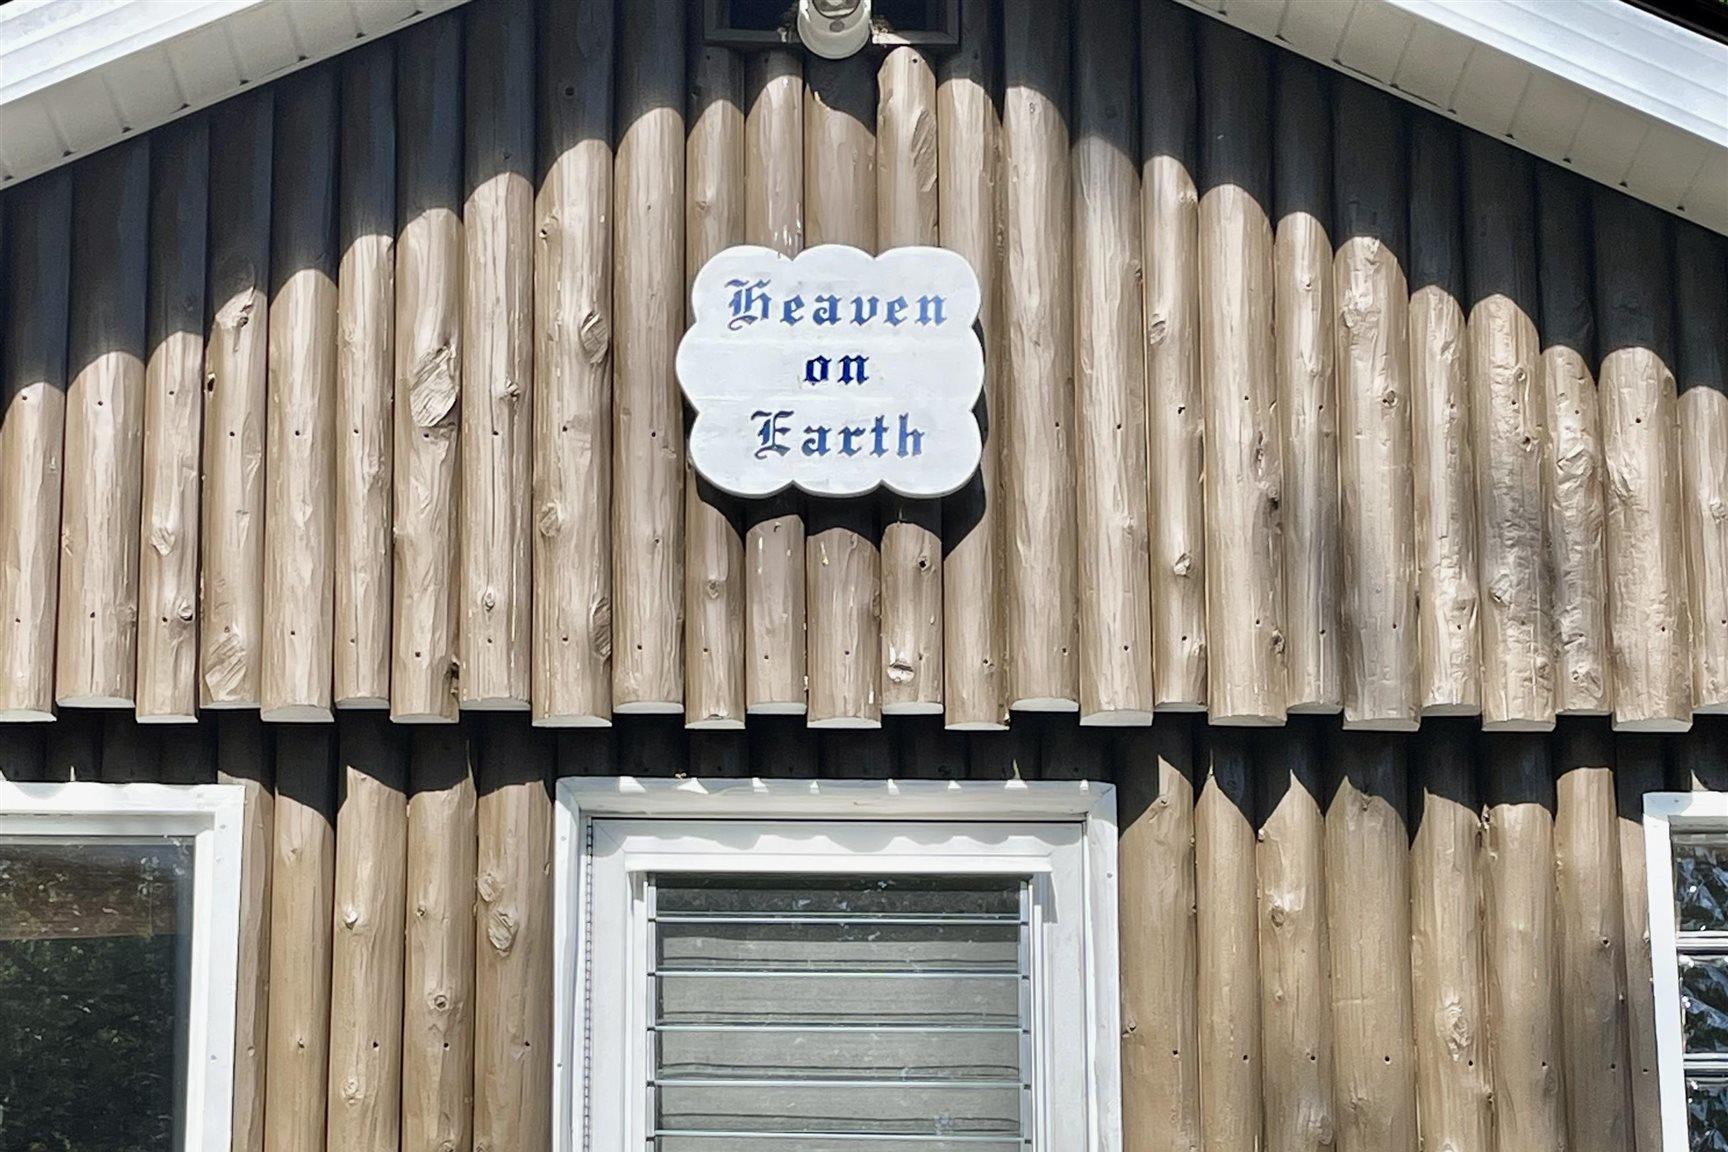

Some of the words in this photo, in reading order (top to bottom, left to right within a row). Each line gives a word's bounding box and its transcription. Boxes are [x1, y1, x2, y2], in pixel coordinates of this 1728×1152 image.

[724, 279, 947, 331] Heaven
[803, 354, 870, 386] on
[751, 410, 925, 460] Earth
